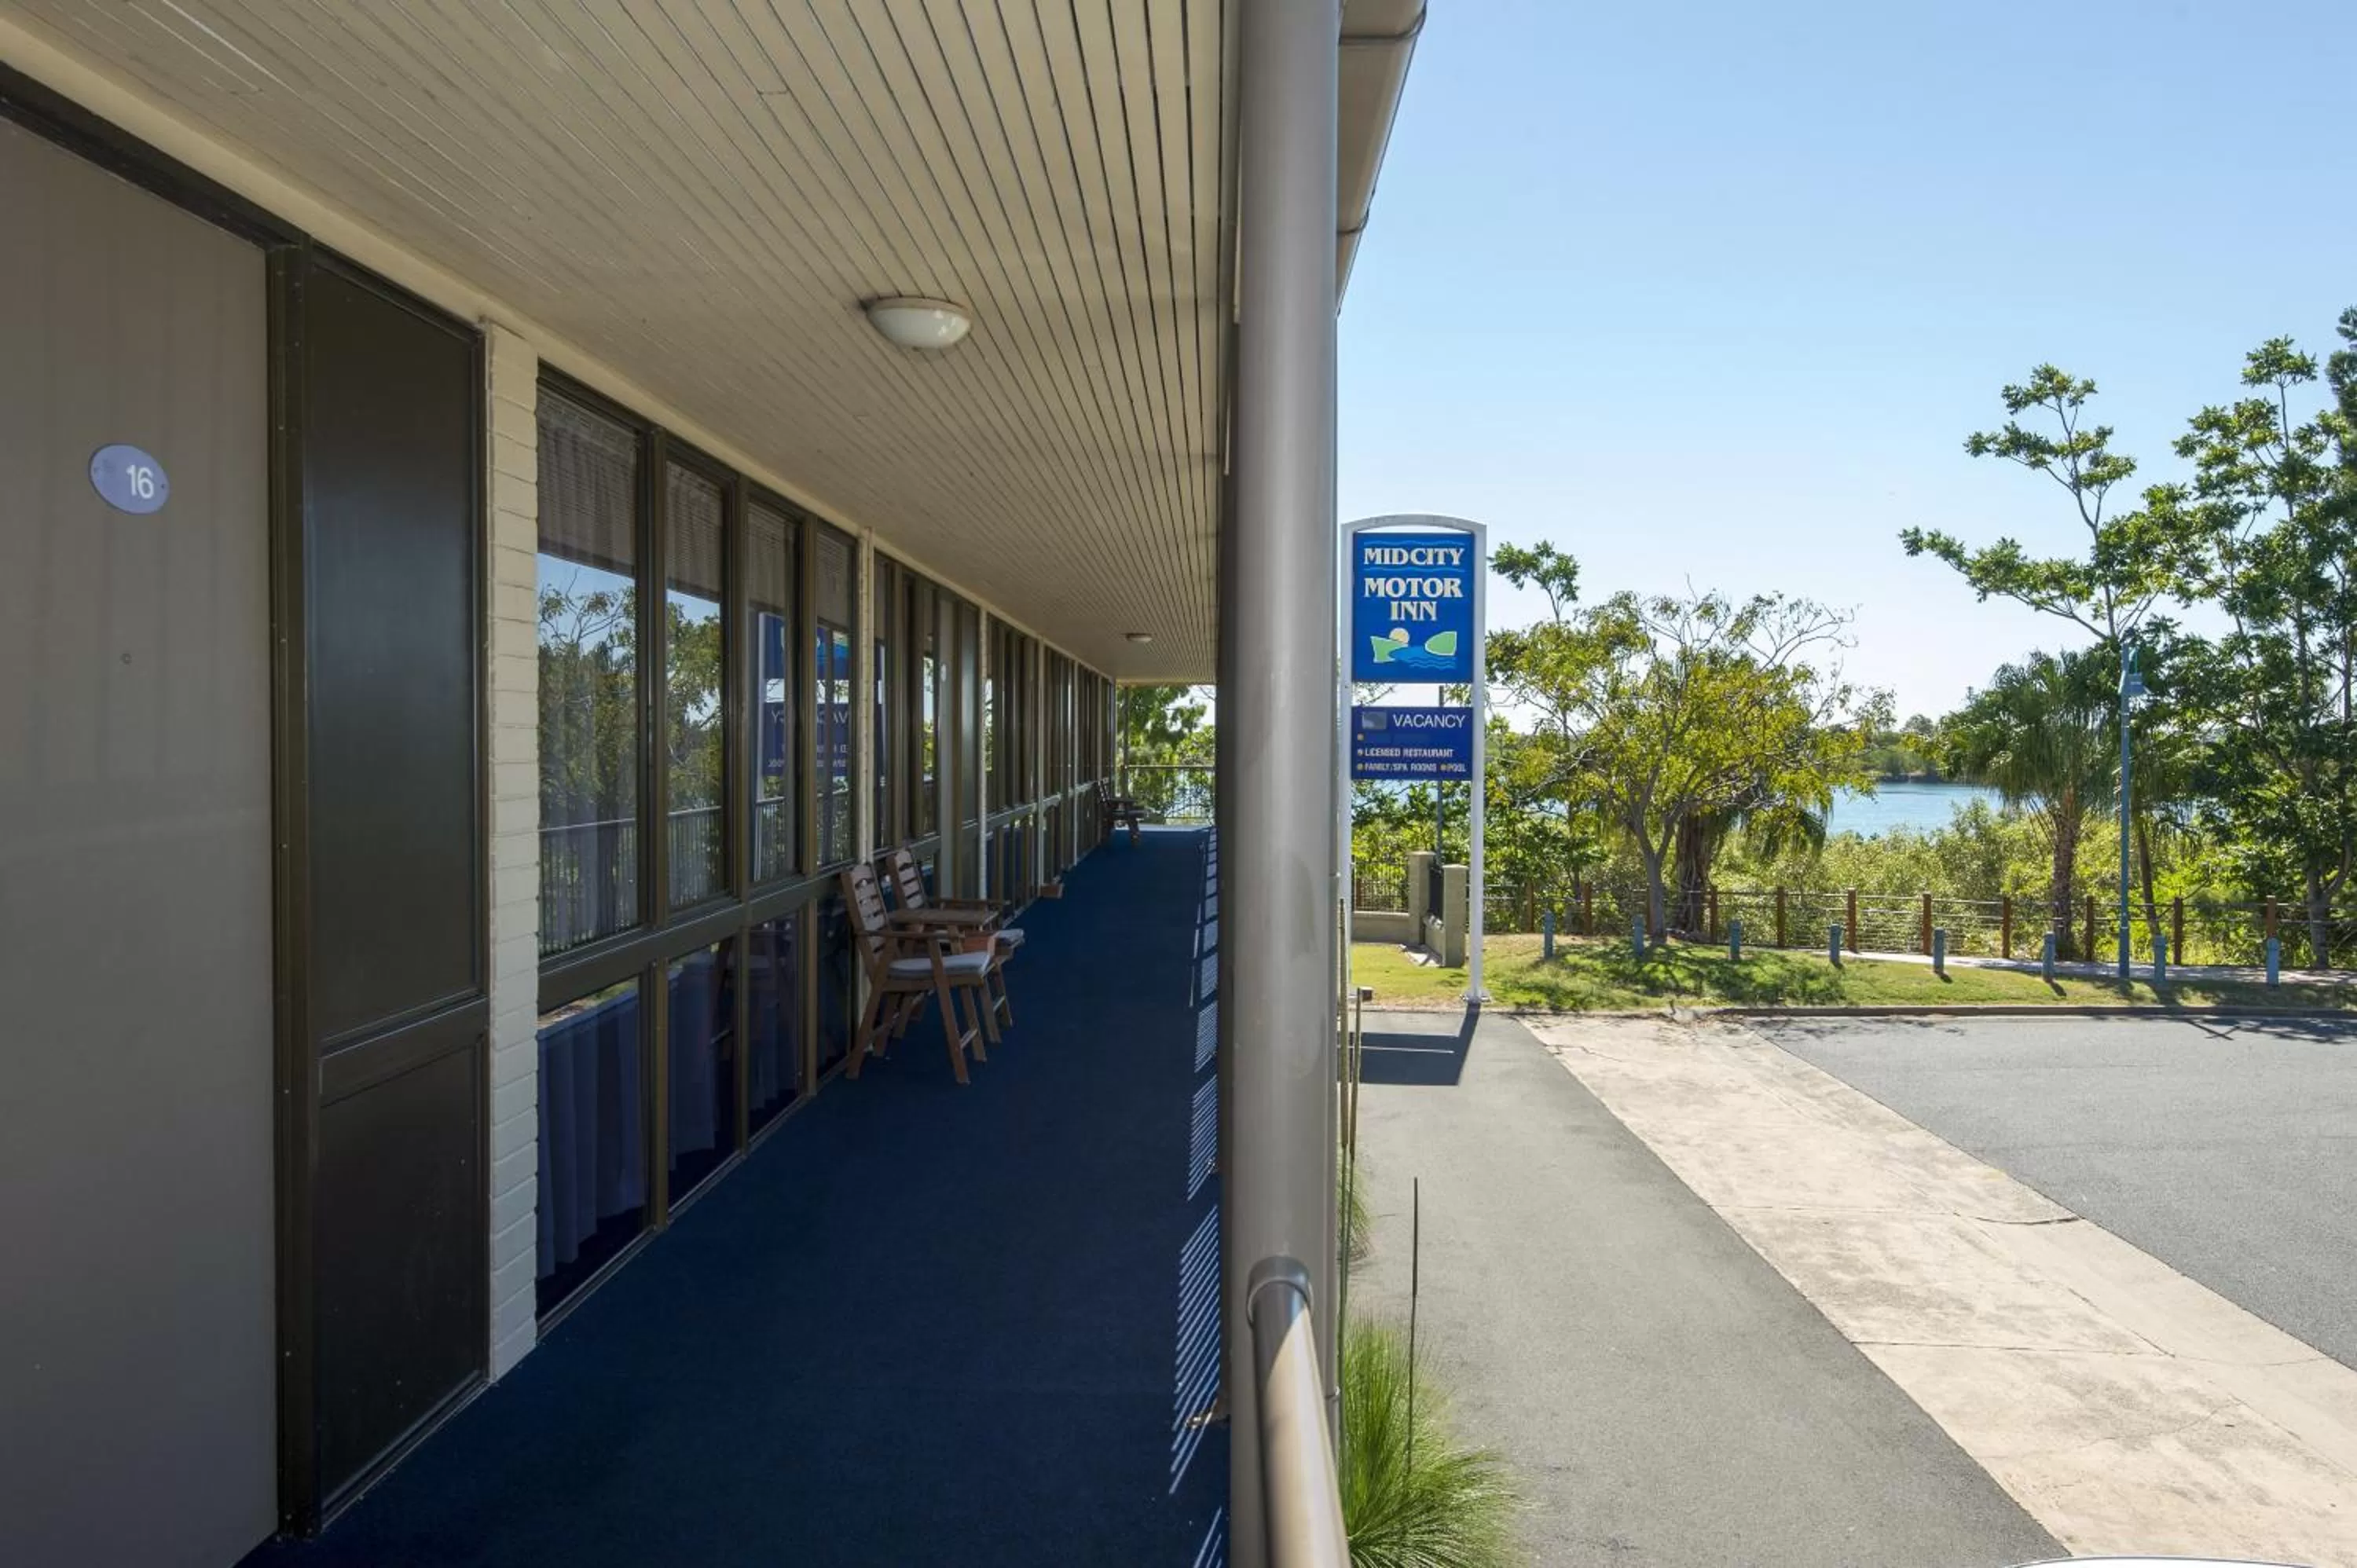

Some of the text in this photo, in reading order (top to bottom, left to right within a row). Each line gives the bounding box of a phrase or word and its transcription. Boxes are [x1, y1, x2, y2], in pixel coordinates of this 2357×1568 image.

[126, 464, 155, 499] 16
[1364, 577, 1463, 598] MOTOR
[1390, 601, 1437, 621] INN
[1392, 714, 1466, 728] VACANCY
[1365, 748, 1453, 758] LICENSED RESTAURANT
[1410, 763, 1437, 772] ROOMS
